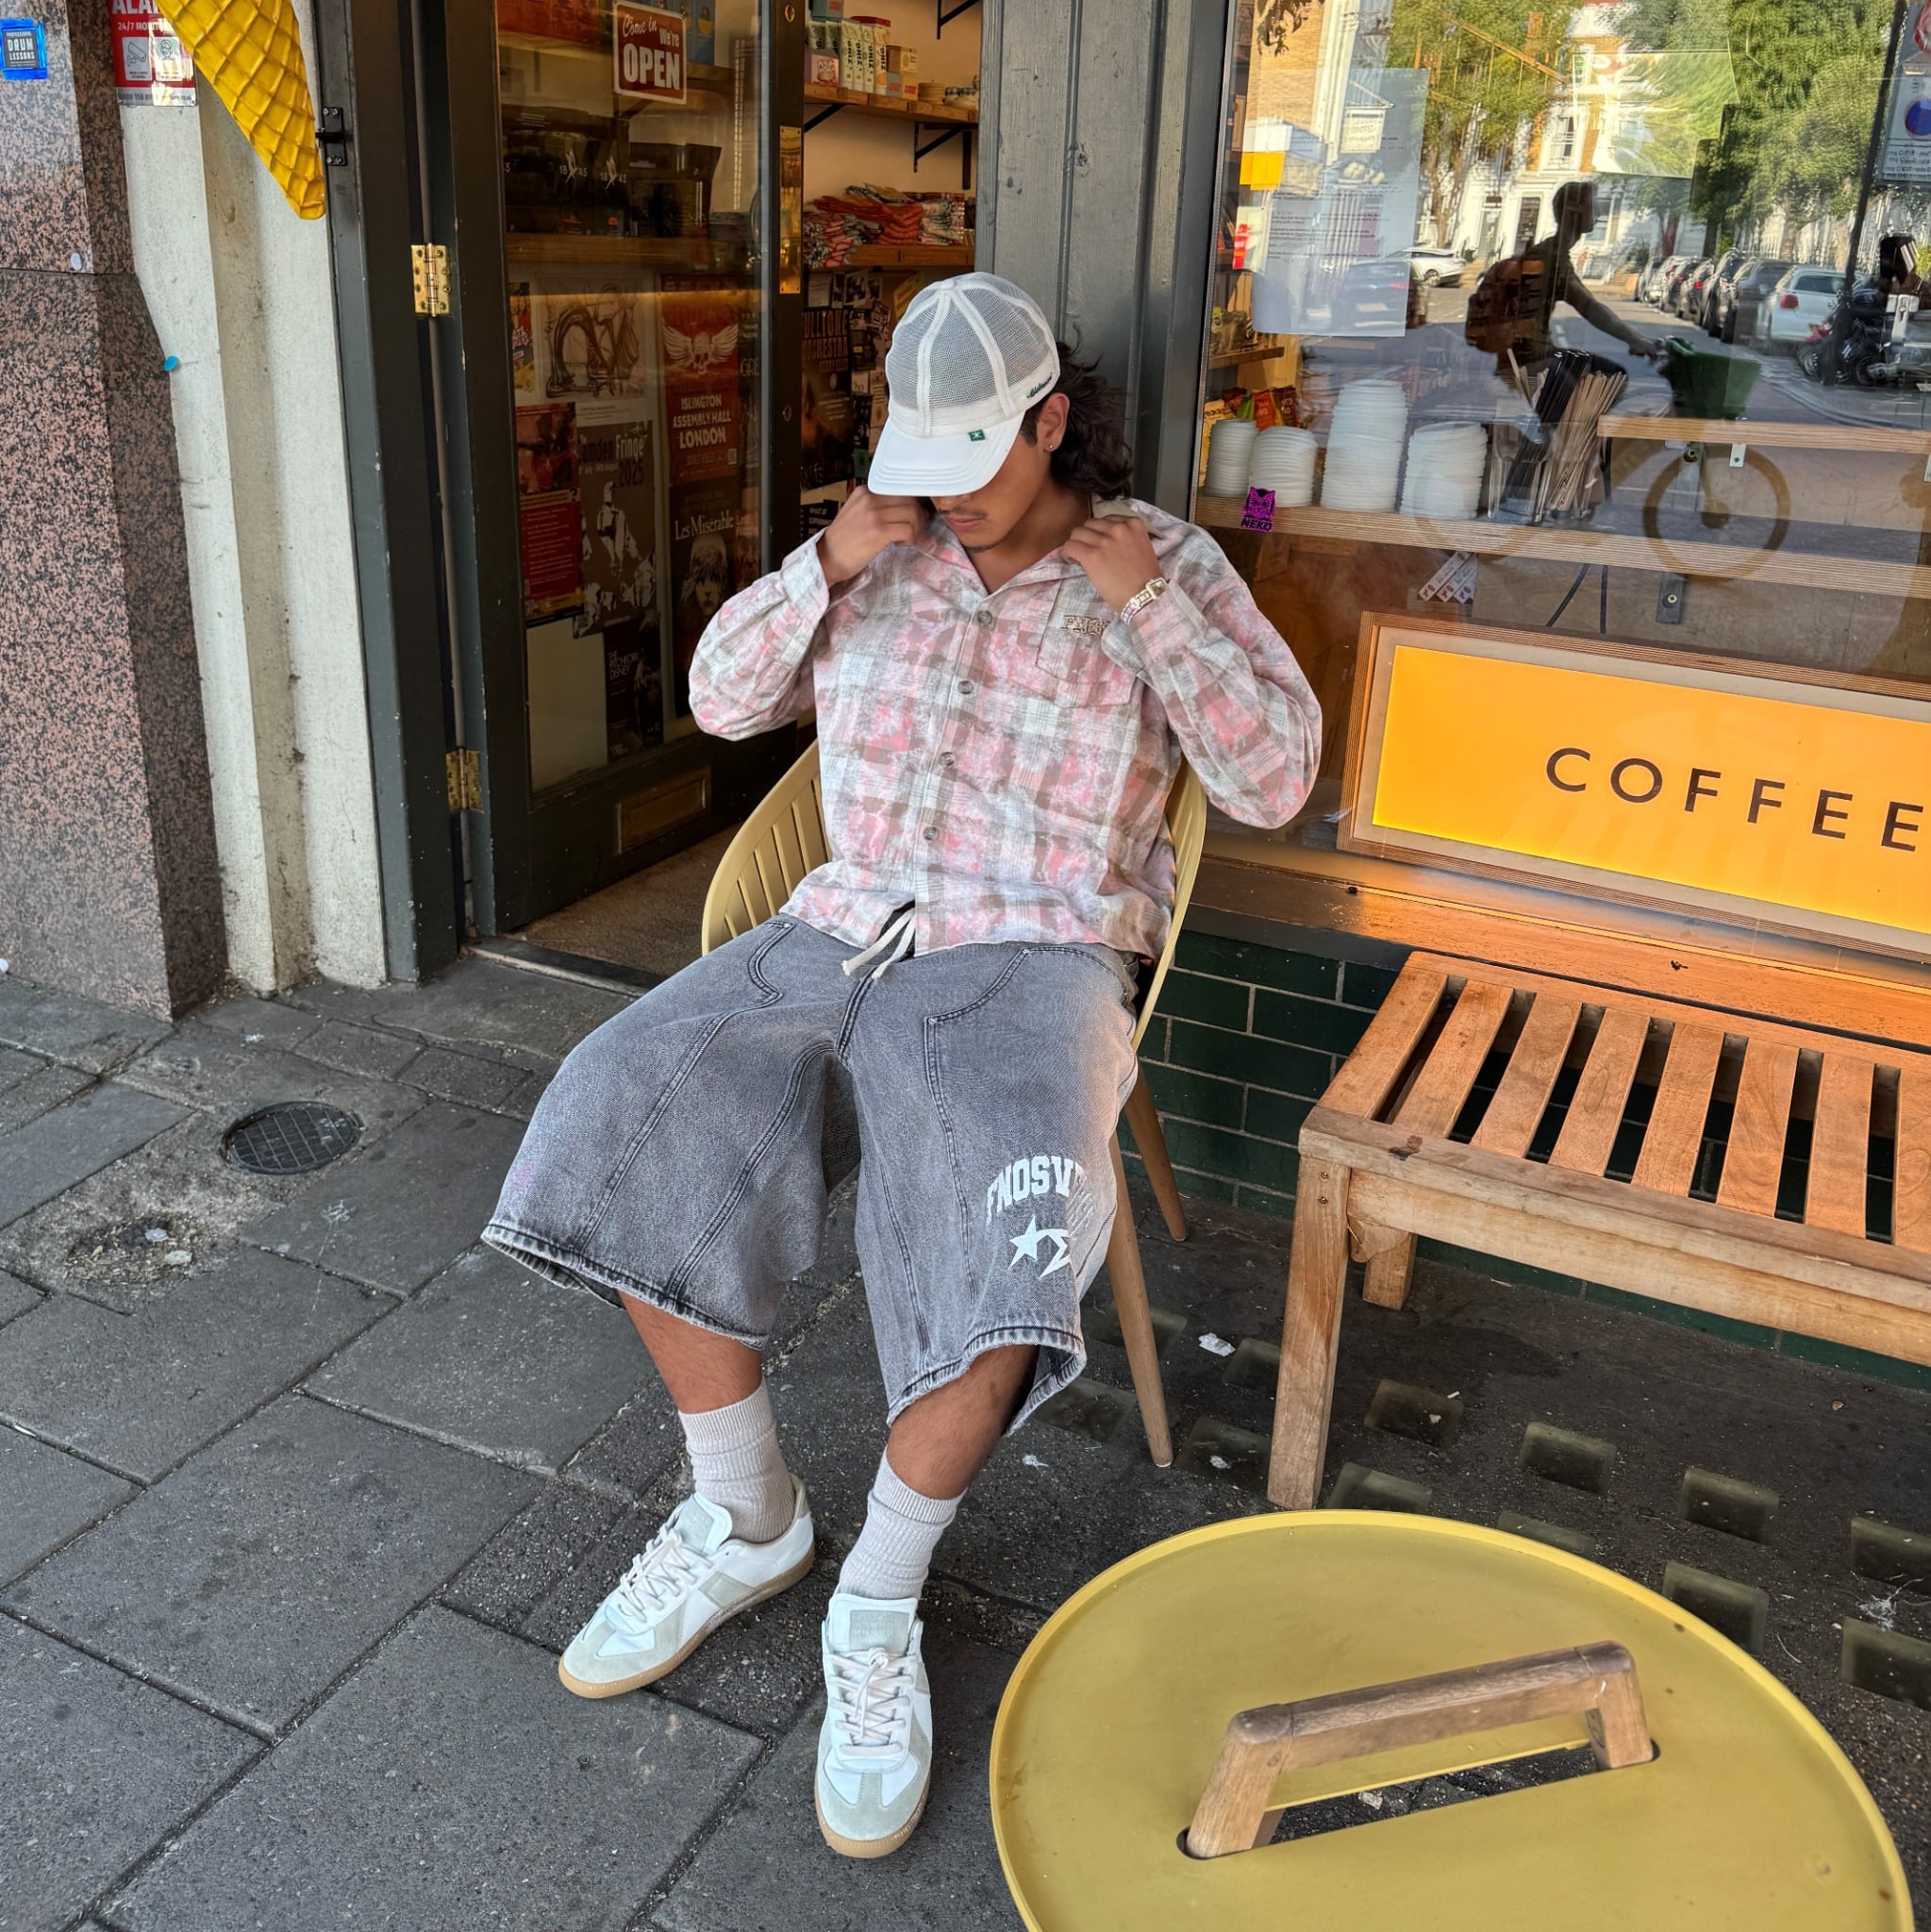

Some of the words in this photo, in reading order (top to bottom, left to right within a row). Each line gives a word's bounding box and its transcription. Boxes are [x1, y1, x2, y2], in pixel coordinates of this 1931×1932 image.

[118, 21, 134, 31] 24/7
[623, 13, 647, 37] Come
[648, 15, 658, 33] in
[8, 38, 33, 51] DRUM
[659, 27, 680, 47] We're
[8, 52, 35, 60] LESSONS
[623, 42, 680, 91] OPEN
[680, 393, 723, 411] ISLINGTON
[672, 411, 712, 430] ASSEMBLY
[711, 409, 732, 425] HALL
[615, 432, 644, 463] Fringe
[679, 425, 726, 449] LONDON
[618, 458, 643, 487] 2025
[1240, 518, 1273, 532] NEKO
[1546, 747, 1924, 853] COFFEE
